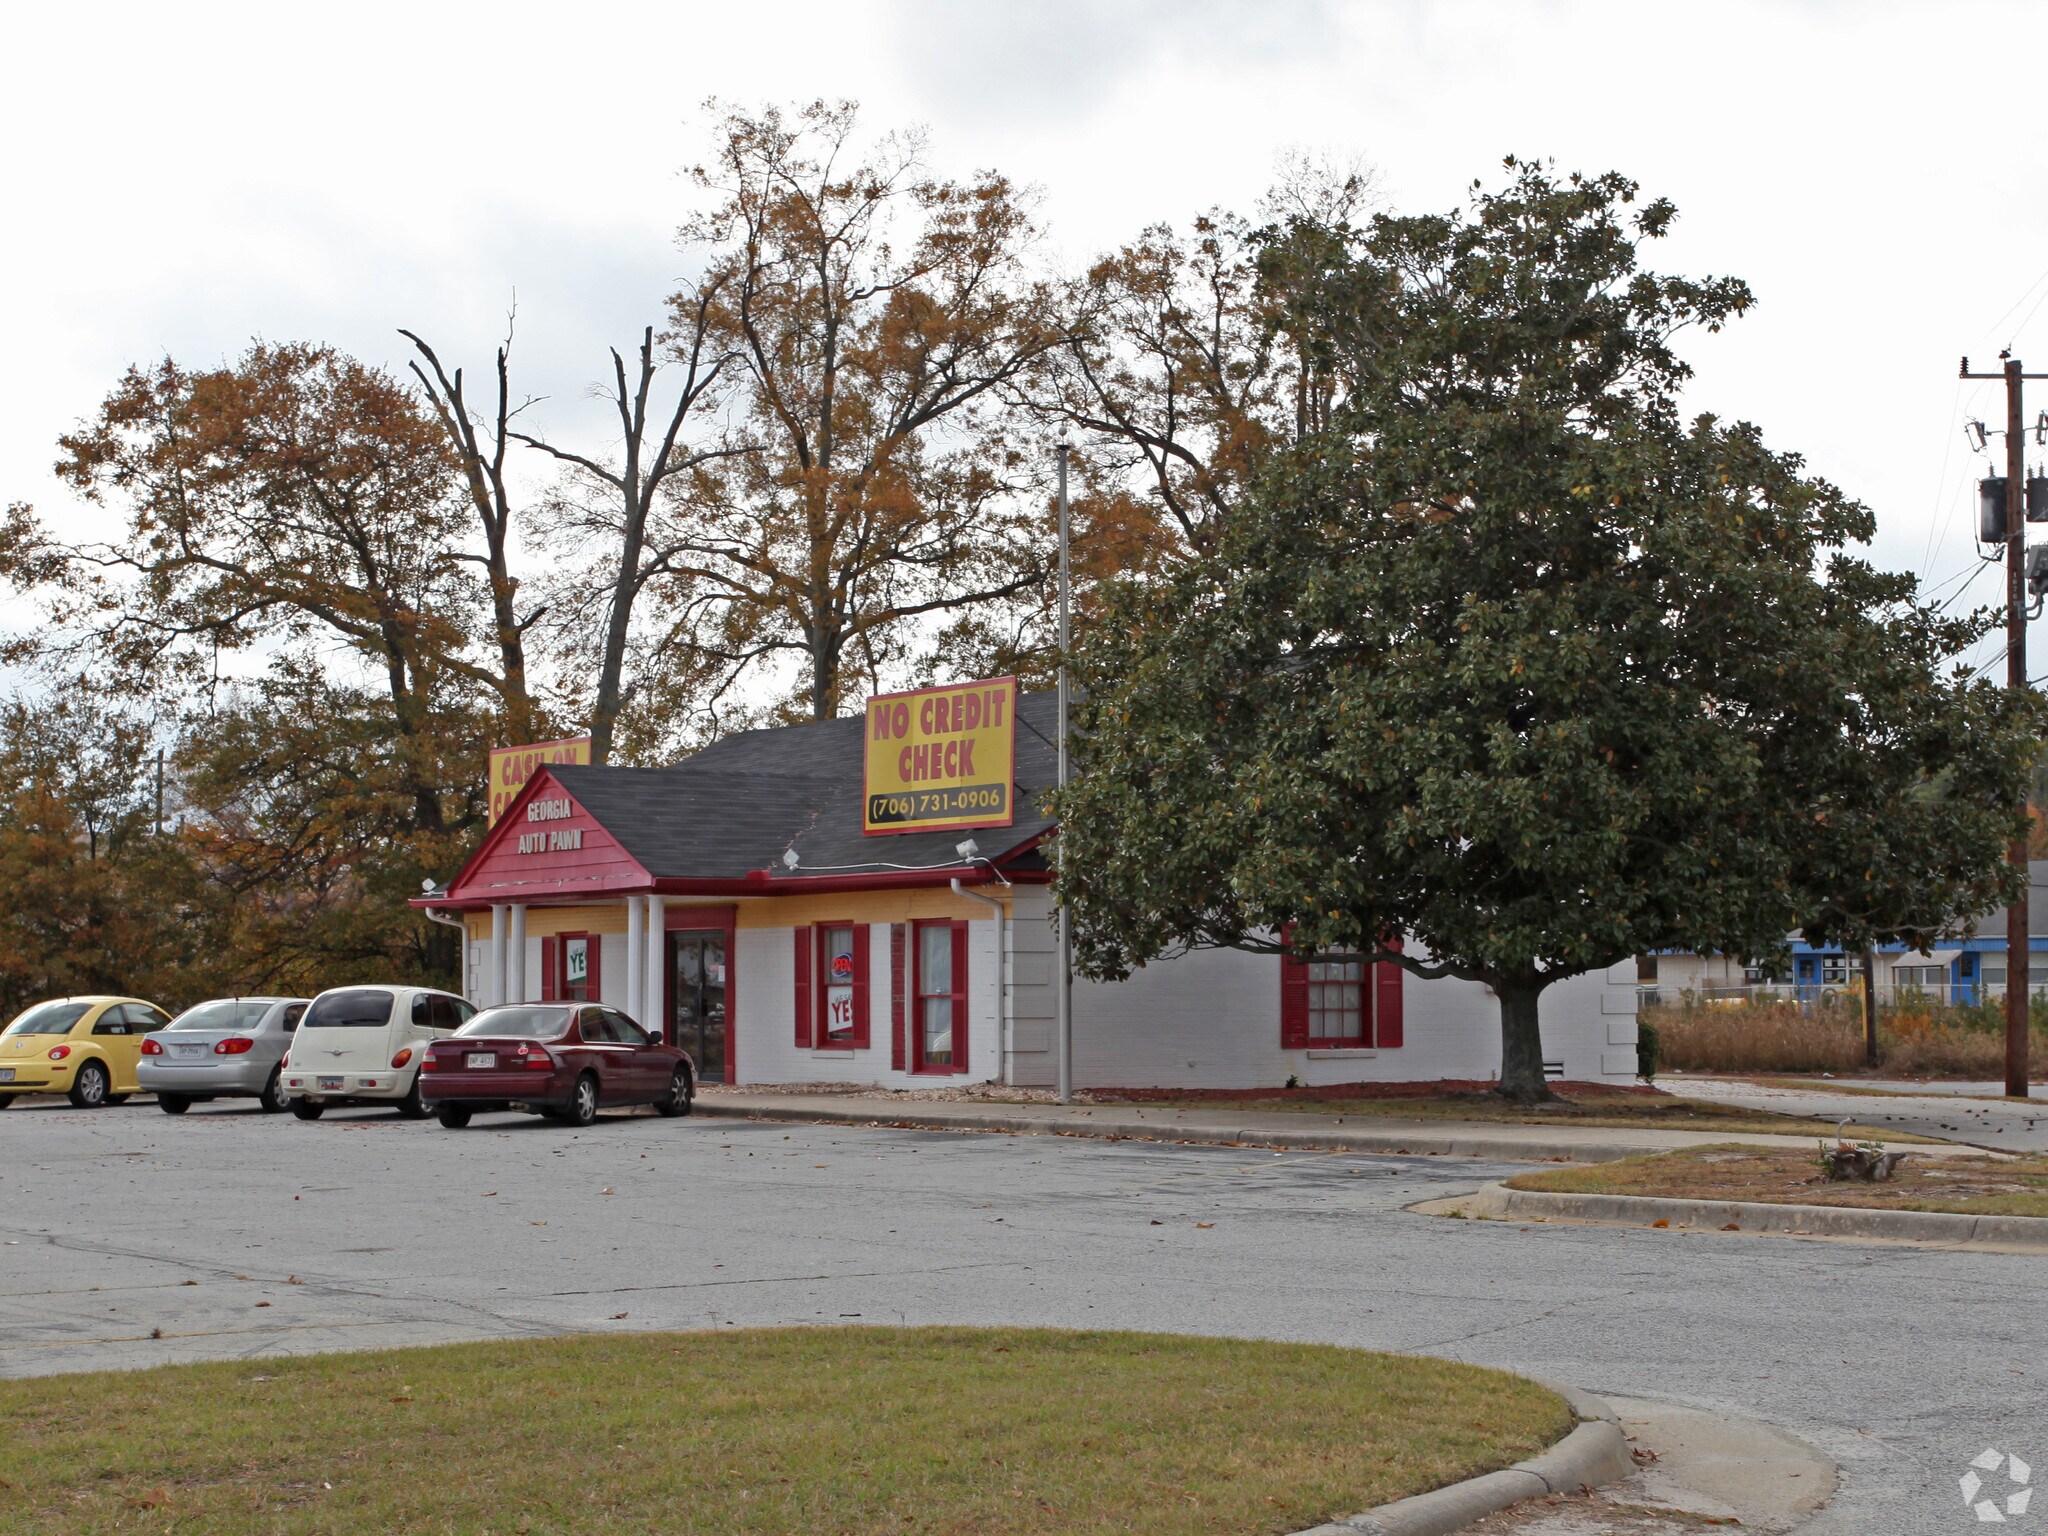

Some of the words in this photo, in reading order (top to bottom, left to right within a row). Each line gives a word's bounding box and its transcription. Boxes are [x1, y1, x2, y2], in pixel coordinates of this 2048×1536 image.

[874, 702, 909, 740] NO
[920, 689, 1006, 735] CREDIT
[898, 739, 975, 782] CHECK
[527, 799, 571, 822] GEORGIA
[873, 796, 915, 819] (706)
[920, 789, 1000, 812] 731-0906
[518, 832, 547, 854] AUTO
[550, 829, 583, 851] PAWN
[570, 952, 587, 973] YE
[832, 957, 852, 972] OPEN
